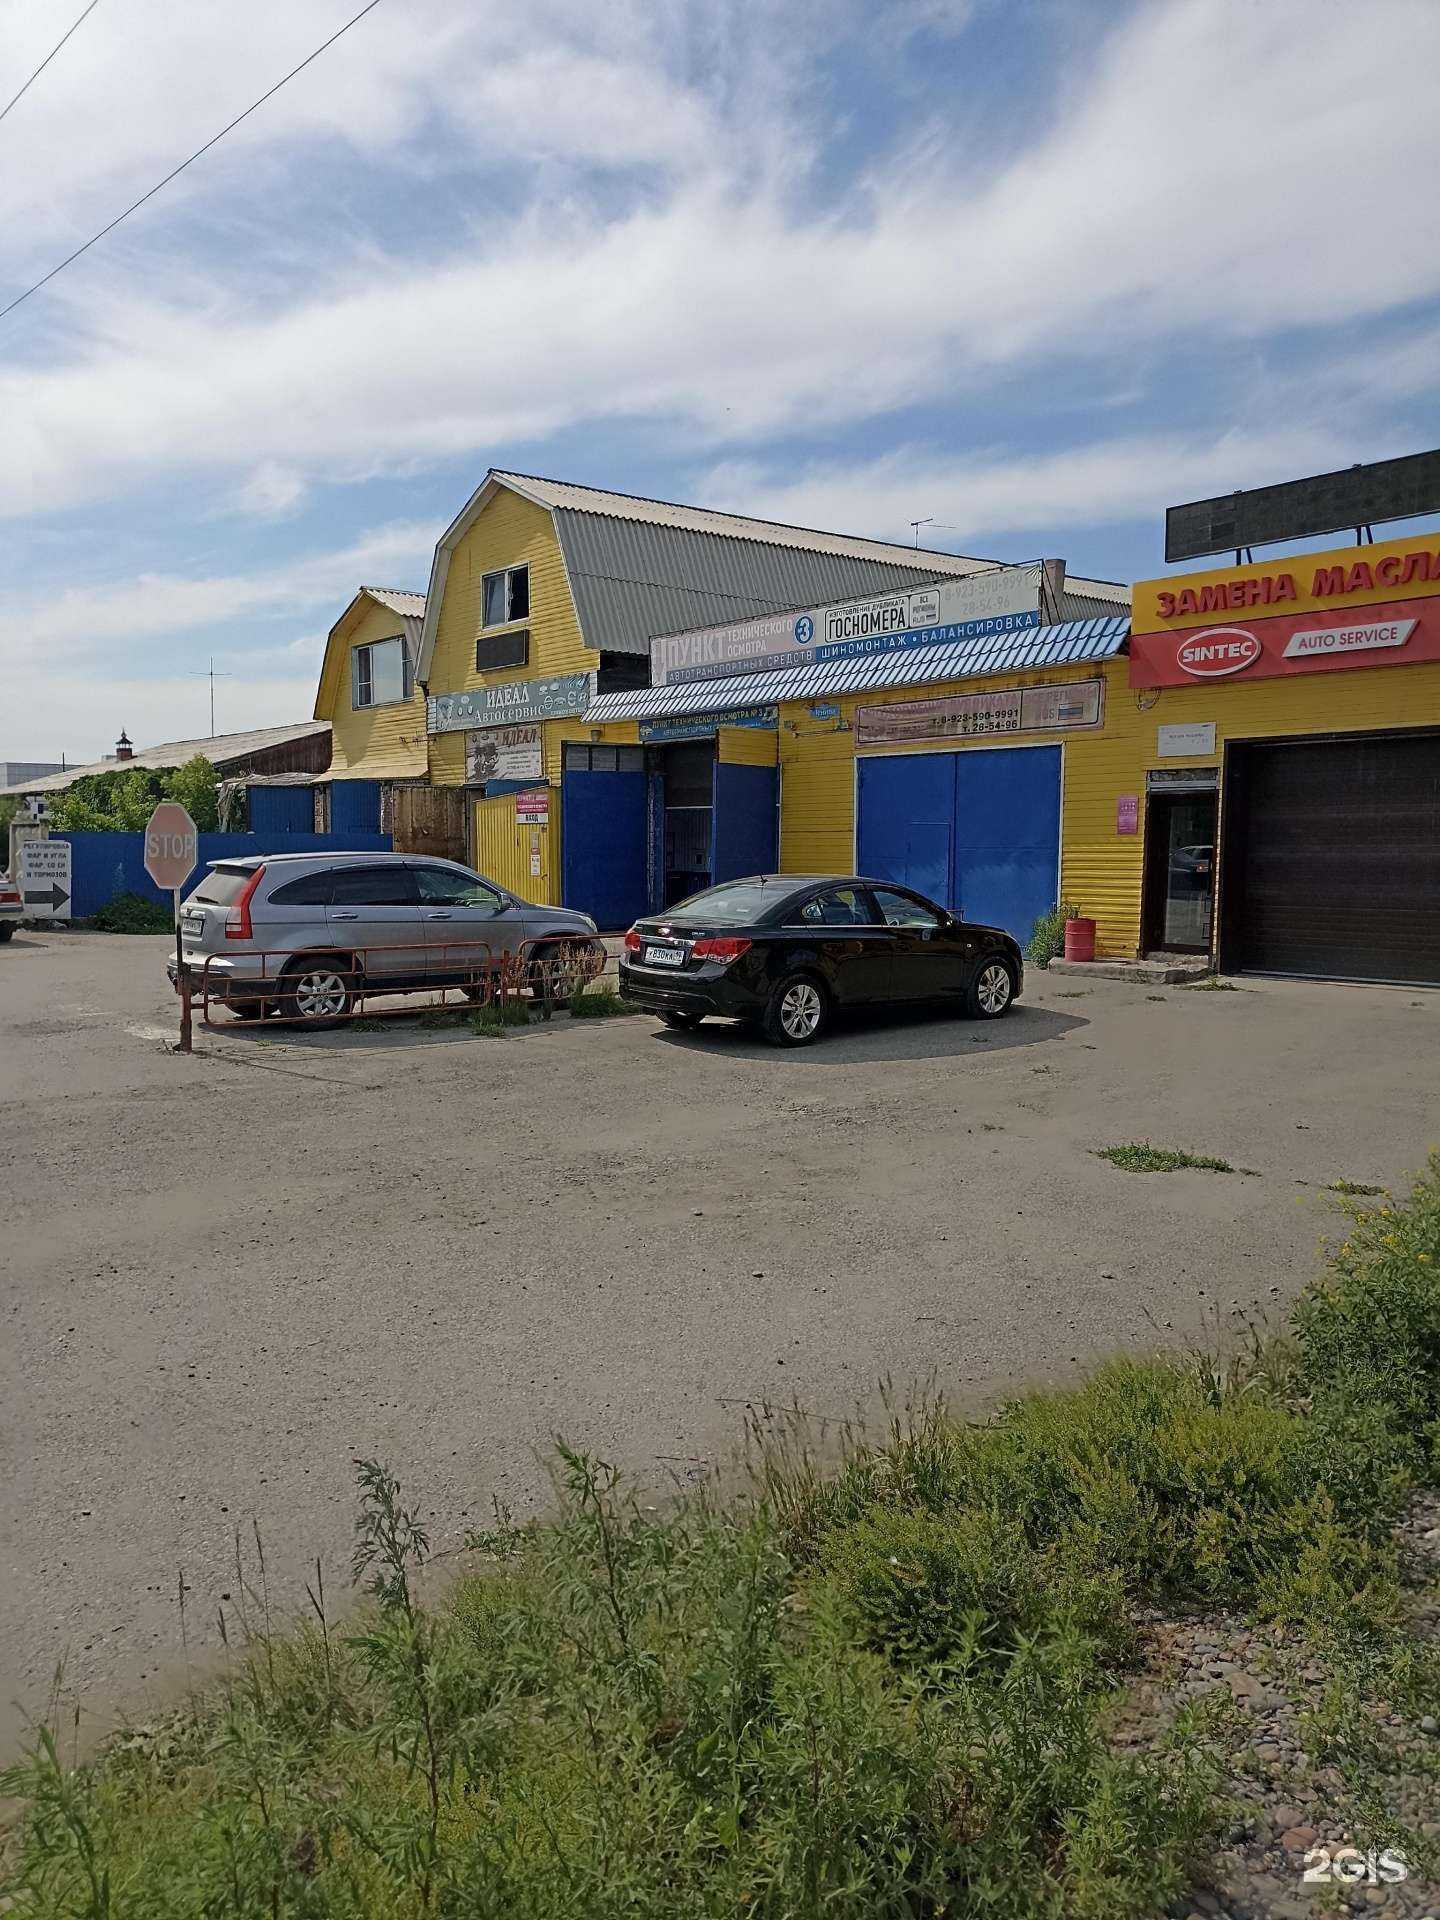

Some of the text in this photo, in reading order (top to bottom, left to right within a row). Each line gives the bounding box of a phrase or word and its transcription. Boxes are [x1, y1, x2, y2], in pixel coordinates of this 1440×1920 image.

[1156, 573, 1297, 618] ЗАМЕНА
[727, 619, 793, 642] ТЕХНИЧЕСКОГО
[829, 606, 906, 639] ГОСНОМЕРА
[727, 639, 767, 657] ОСМОТРА
[821, 614, 1033, 659] ШИНОМОНТАЖ БАЛАНСИРОВКА
[1298, 626, 1398, 650] AUTO SERVICE
[670, 634, 725, 668] ПУНКТ
[1182, 641, 1254, 663] SINTEC
[669, 650, 813, 682] АВТОТРАНСПОРТНЫХ СРЕДСТВ
[486, 685, 530, 709] ИДЕАЛ
[474, 704, 545, 723] Автосервис
[941, 709, 1019, 724] 8-923-590-9991
[972, 720, 1018, 732] 28-54-96
[149, 832, 194, 858] STOP
